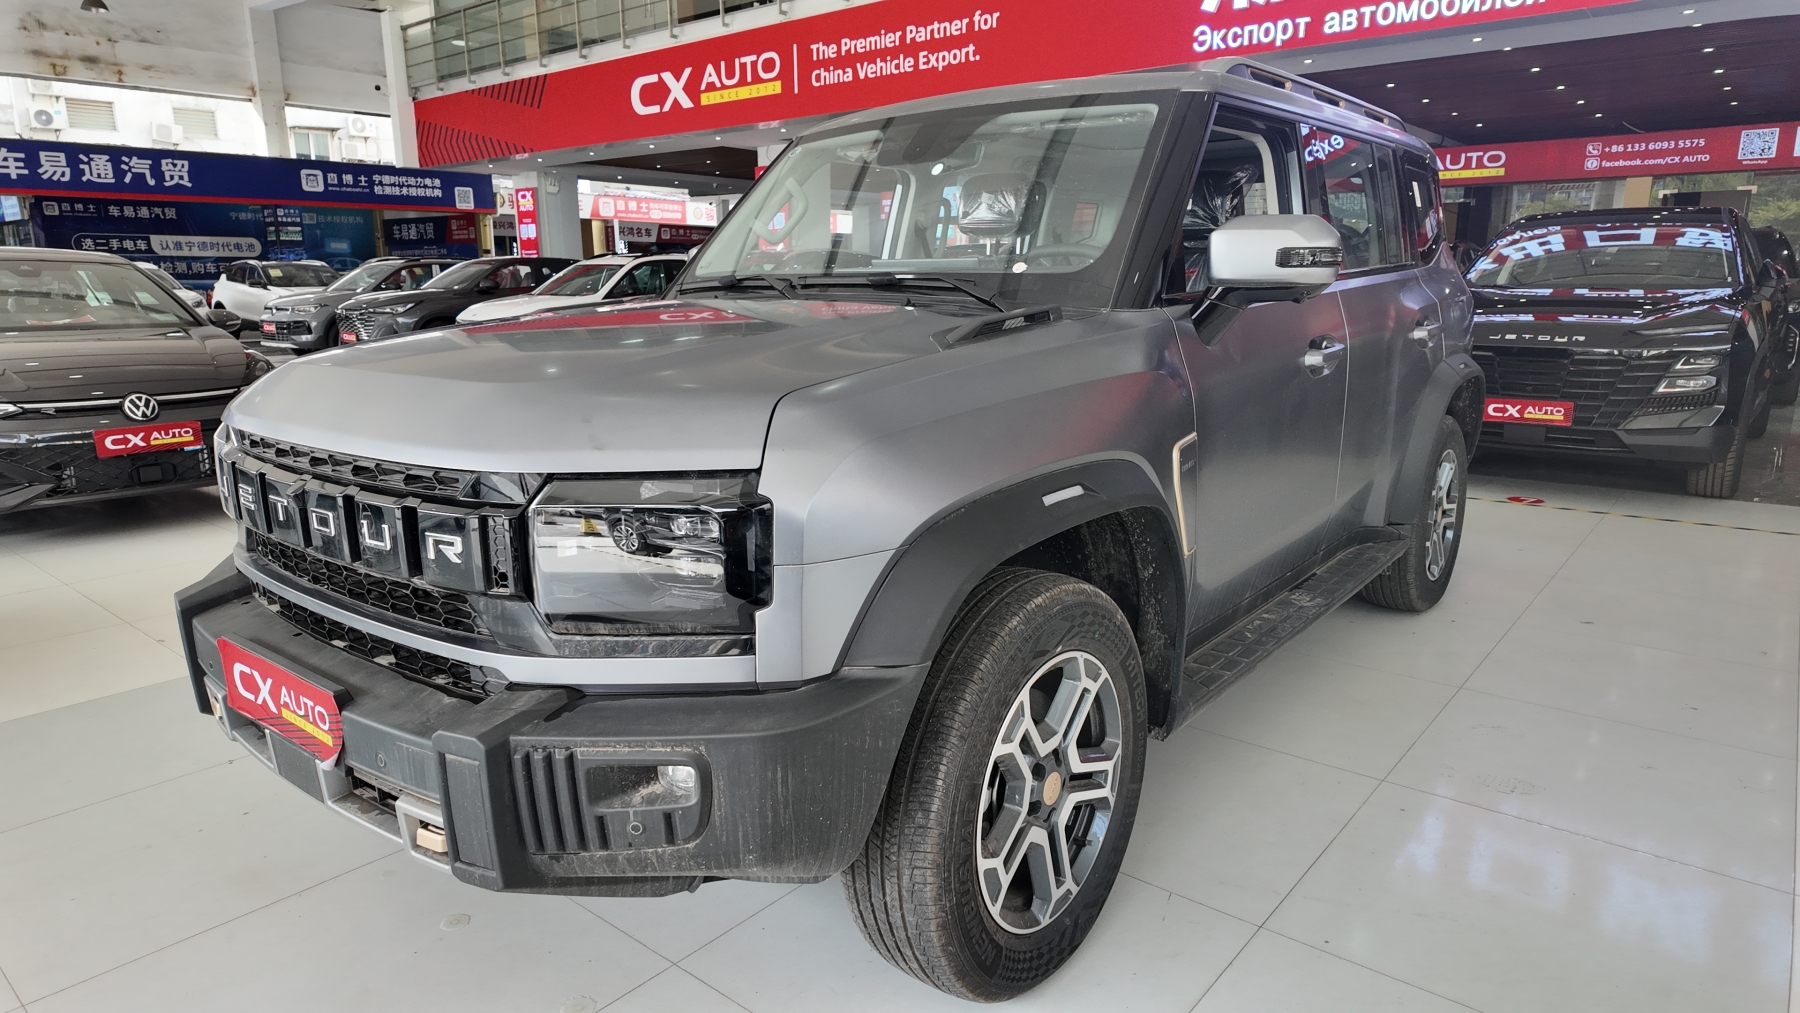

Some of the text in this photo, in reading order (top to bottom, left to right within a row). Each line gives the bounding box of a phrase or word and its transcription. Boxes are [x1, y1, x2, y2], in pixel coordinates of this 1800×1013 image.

[810, 10, 1000, 61] The Premier Partner for
[1193, 16, 1311, 52] Экспорт
[811, 43, 981, 87] China Vehicle Export.
[630, 51, 781, 115] CX AUTO
[706, 84, 777, 103] SINCE 2012
[1604, 138, 1706, 153] +86 133 6093 5575
[0, 147, 193, 188] 车易通汽贸
[1601, 154, 1710, 168] facebook.com/CX AUTO
[373, 174, 441, 187] 宁德时代动力电池
[1472, 169, 1500, 177] 2012
[374, 185, 442, 198] 检测技术授权机构
[518, 191, 533, 202] CX
[107, 205, 177, 220] 车易通汽贸
[392, 222, 435, 241] 车易通汽贸
[81, 238, 149, 251] 选二手电车
[159, 240, 257, 253] 认准宁德时代电池
[1488, 333, 1586, 343] JETOUR
[1487, 403, 1522, 418] CX
[1524, 405, 1565, 416] AUTO
[104, 432, 148, 450] CX
[150, 427, 193, 441] AUTO
[219, 476, 463, 564] JETOUR
[233, 662, 330, 731] CX AUTO
